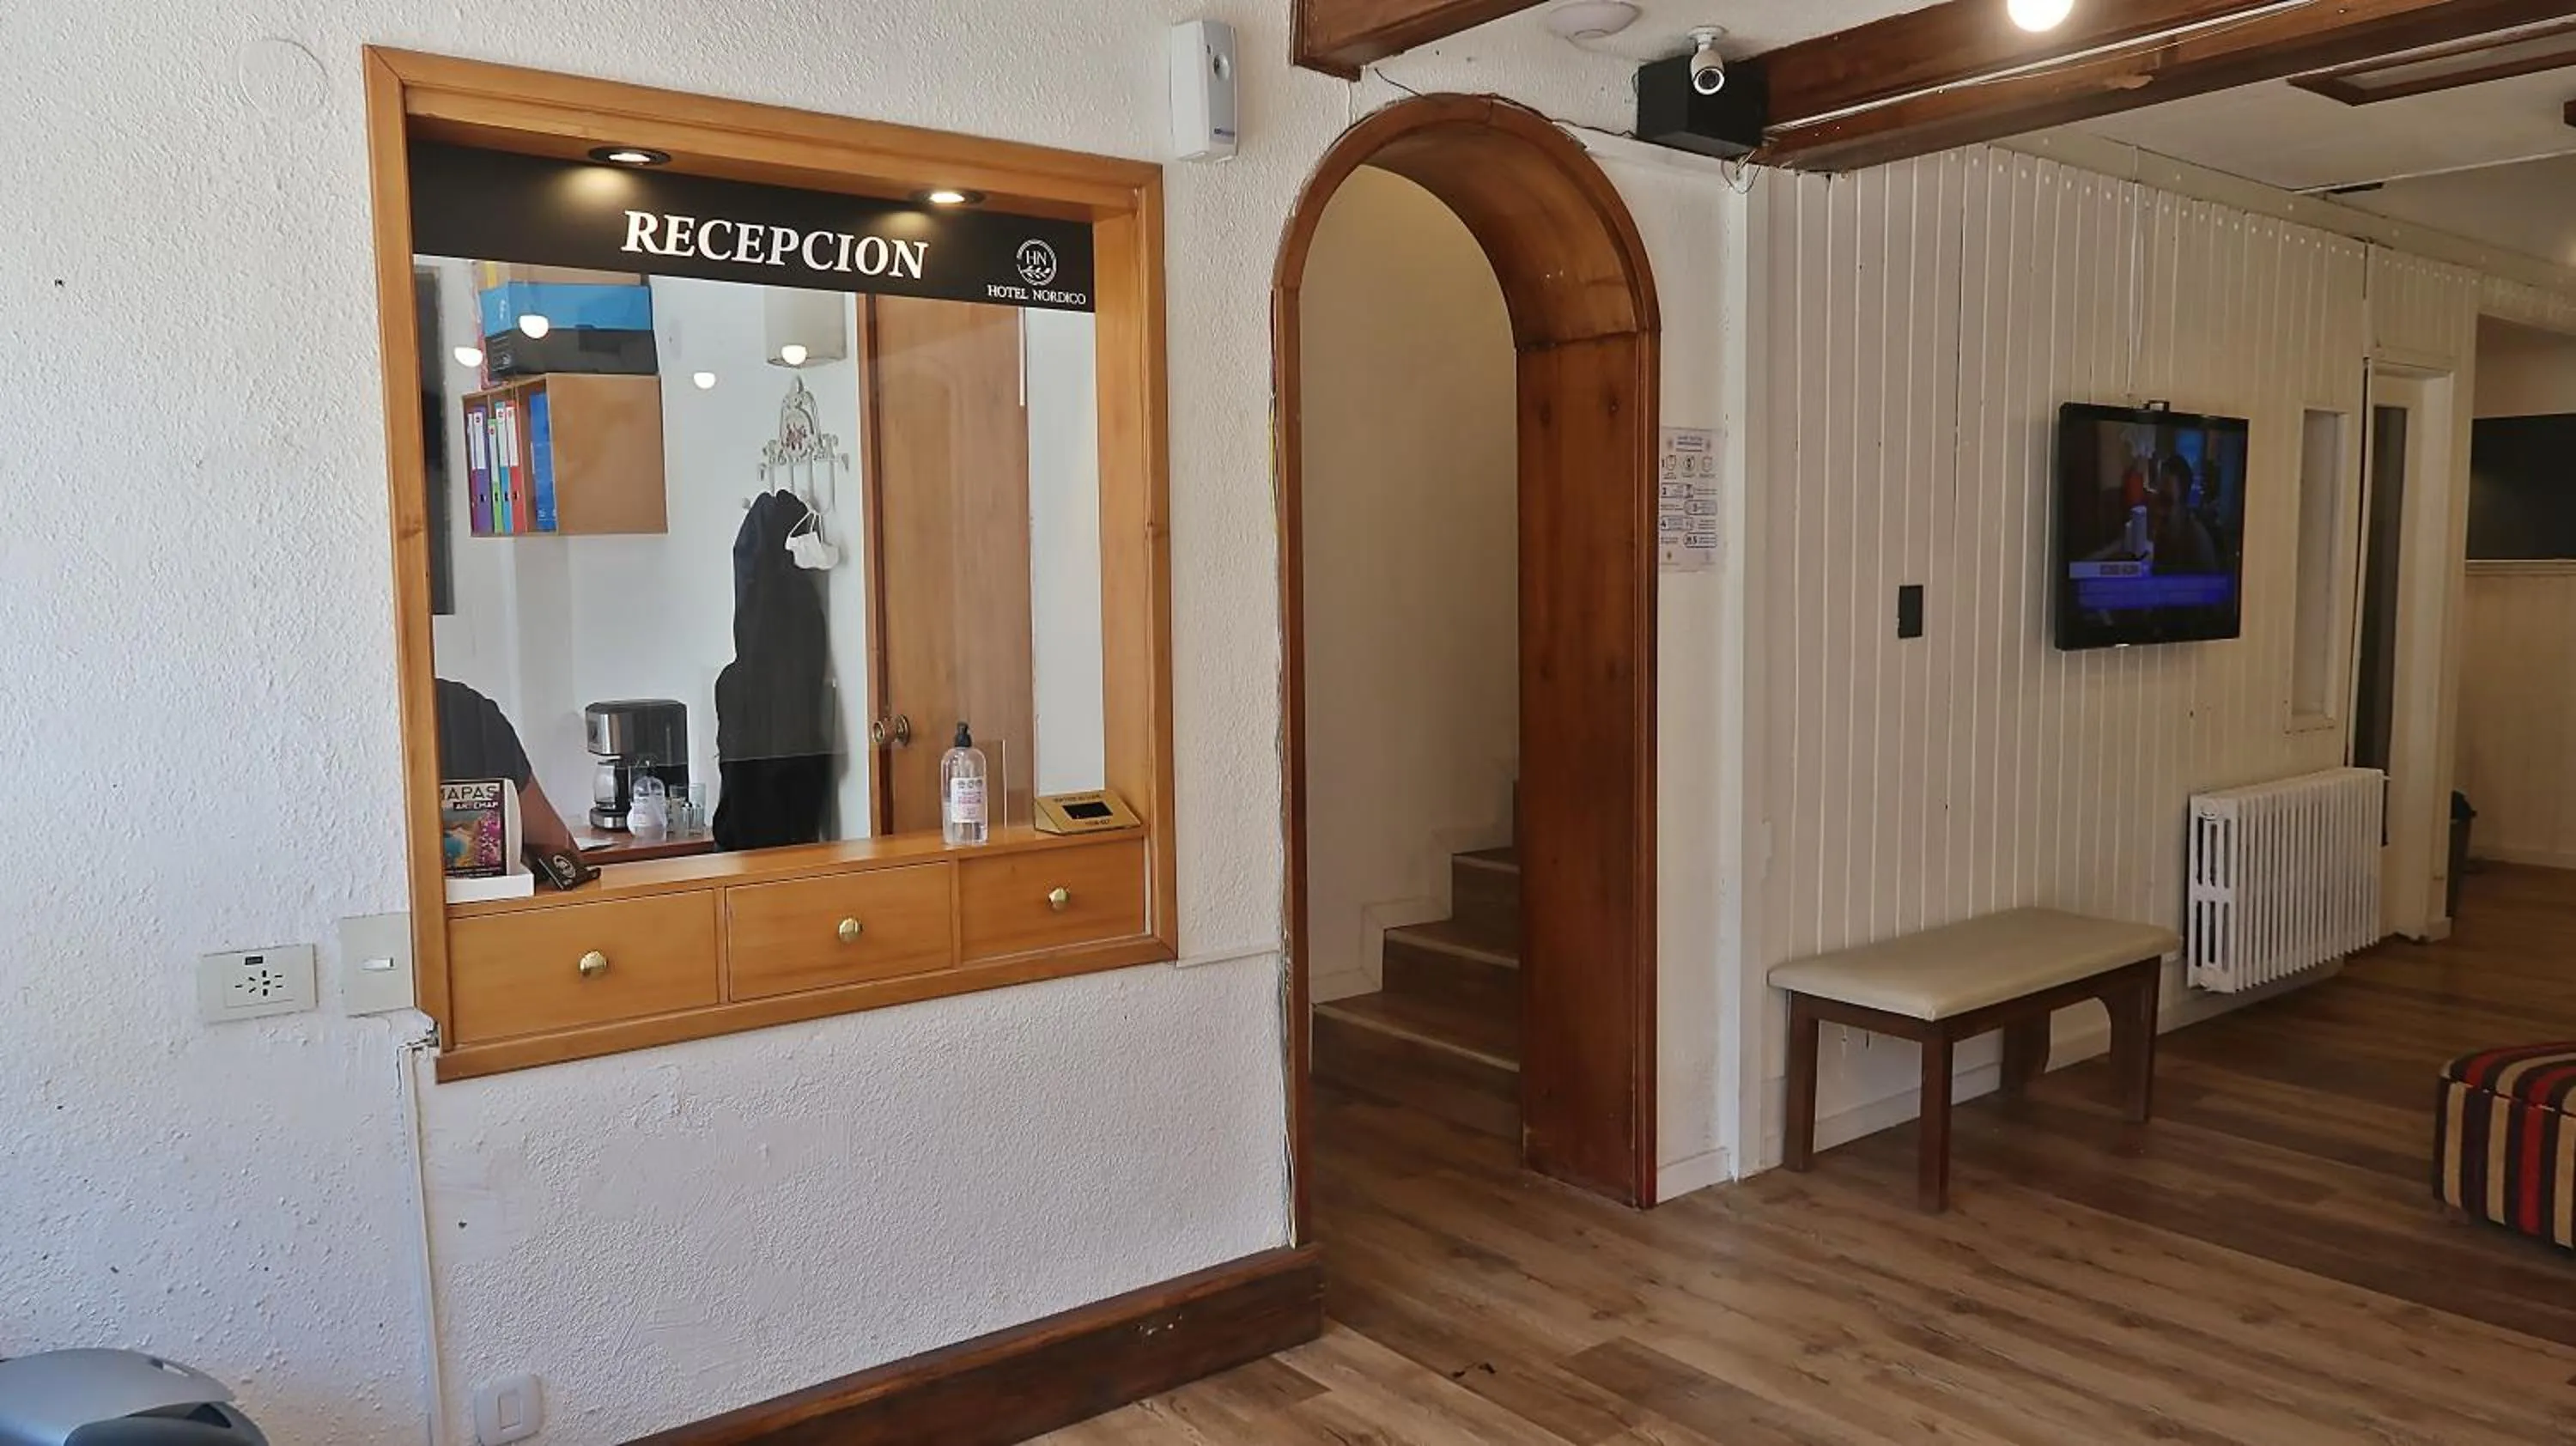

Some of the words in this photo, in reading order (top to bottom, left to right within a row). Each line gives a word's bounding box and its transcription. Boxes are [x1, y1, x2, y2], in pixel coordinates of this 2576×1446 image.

[620, 210, 930, 279] RECEPCION
[1026, 250, 1047, 265] HN
[987, 284, 1030, 300] HOTEL
[1033, 289, 1086, 305] NORDICO
